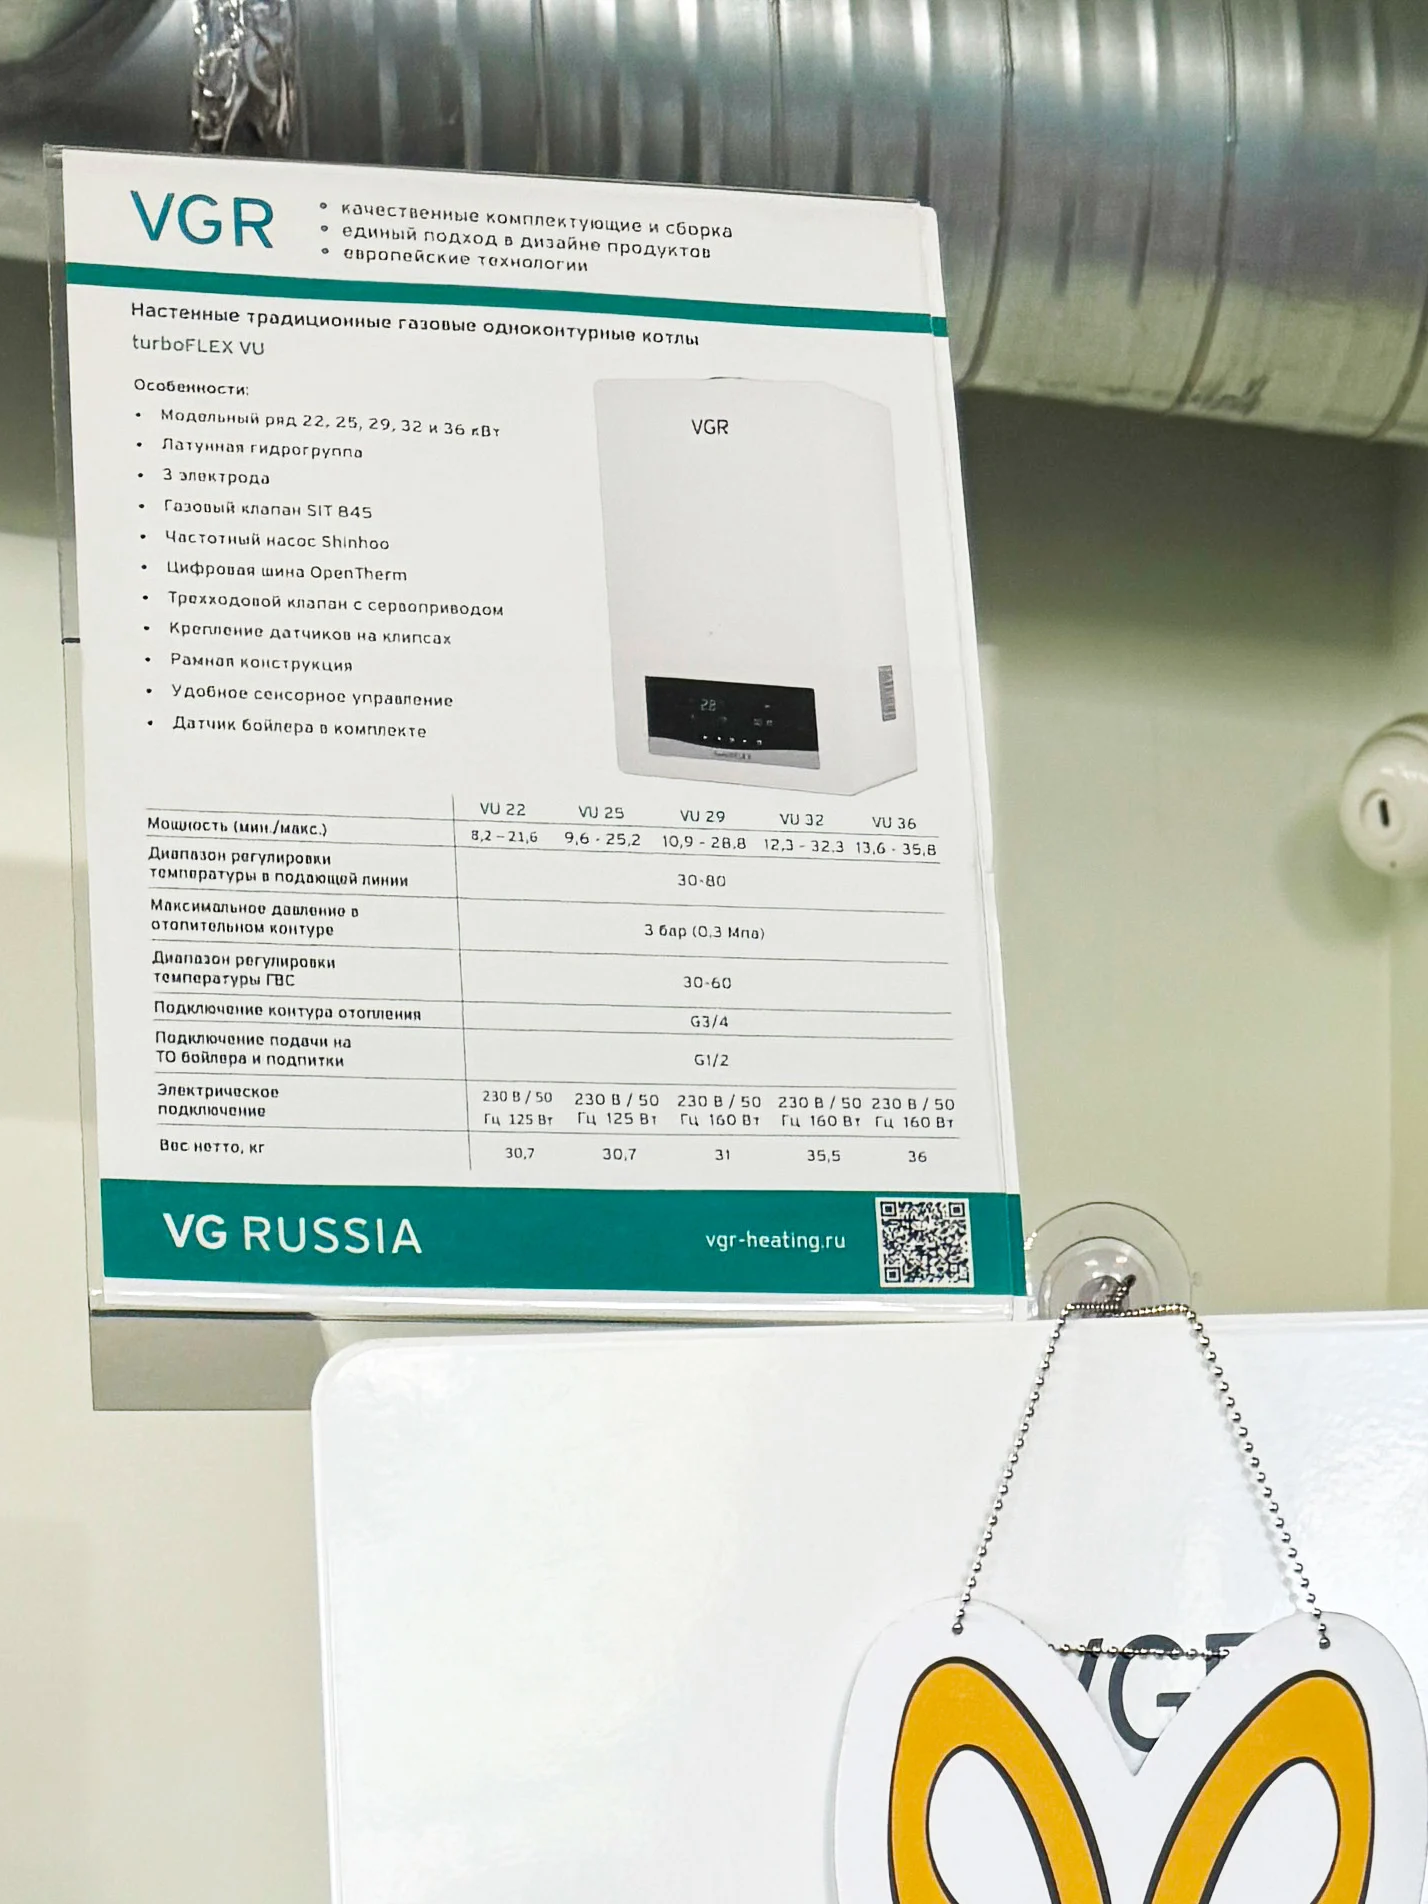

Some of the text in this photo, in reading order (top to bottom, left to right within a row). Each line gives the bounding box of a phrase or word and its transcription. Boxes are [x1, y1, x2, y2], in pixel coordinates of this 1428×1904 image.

[129, 189, 274, 249] VGR
[341, 203, 733, 241] качественные комплектующие и сборка
[342, 225, 711, 259] единый подход в дизайне продуктов
[343, 248, 588, 272] европейские технологии
[131, 302, 699, 346] Настенные традиционные газовые одноконтурные котлы
[132, 333, 265, 356] turboFLEX VU
[133, 378, 250, 396] Особенности:
[161, 408, 500, 438] Модельный ряд 22, 25, 29, 32 и 36 кВт
[691, 418, 729, 435] VGR
[161, 437, 363, 460] Латунная гидрогруппа
[162, 1212, 423, 1254] VG RUSSIA
[705, 1229, 846, 1253] vgr-heating.ru
